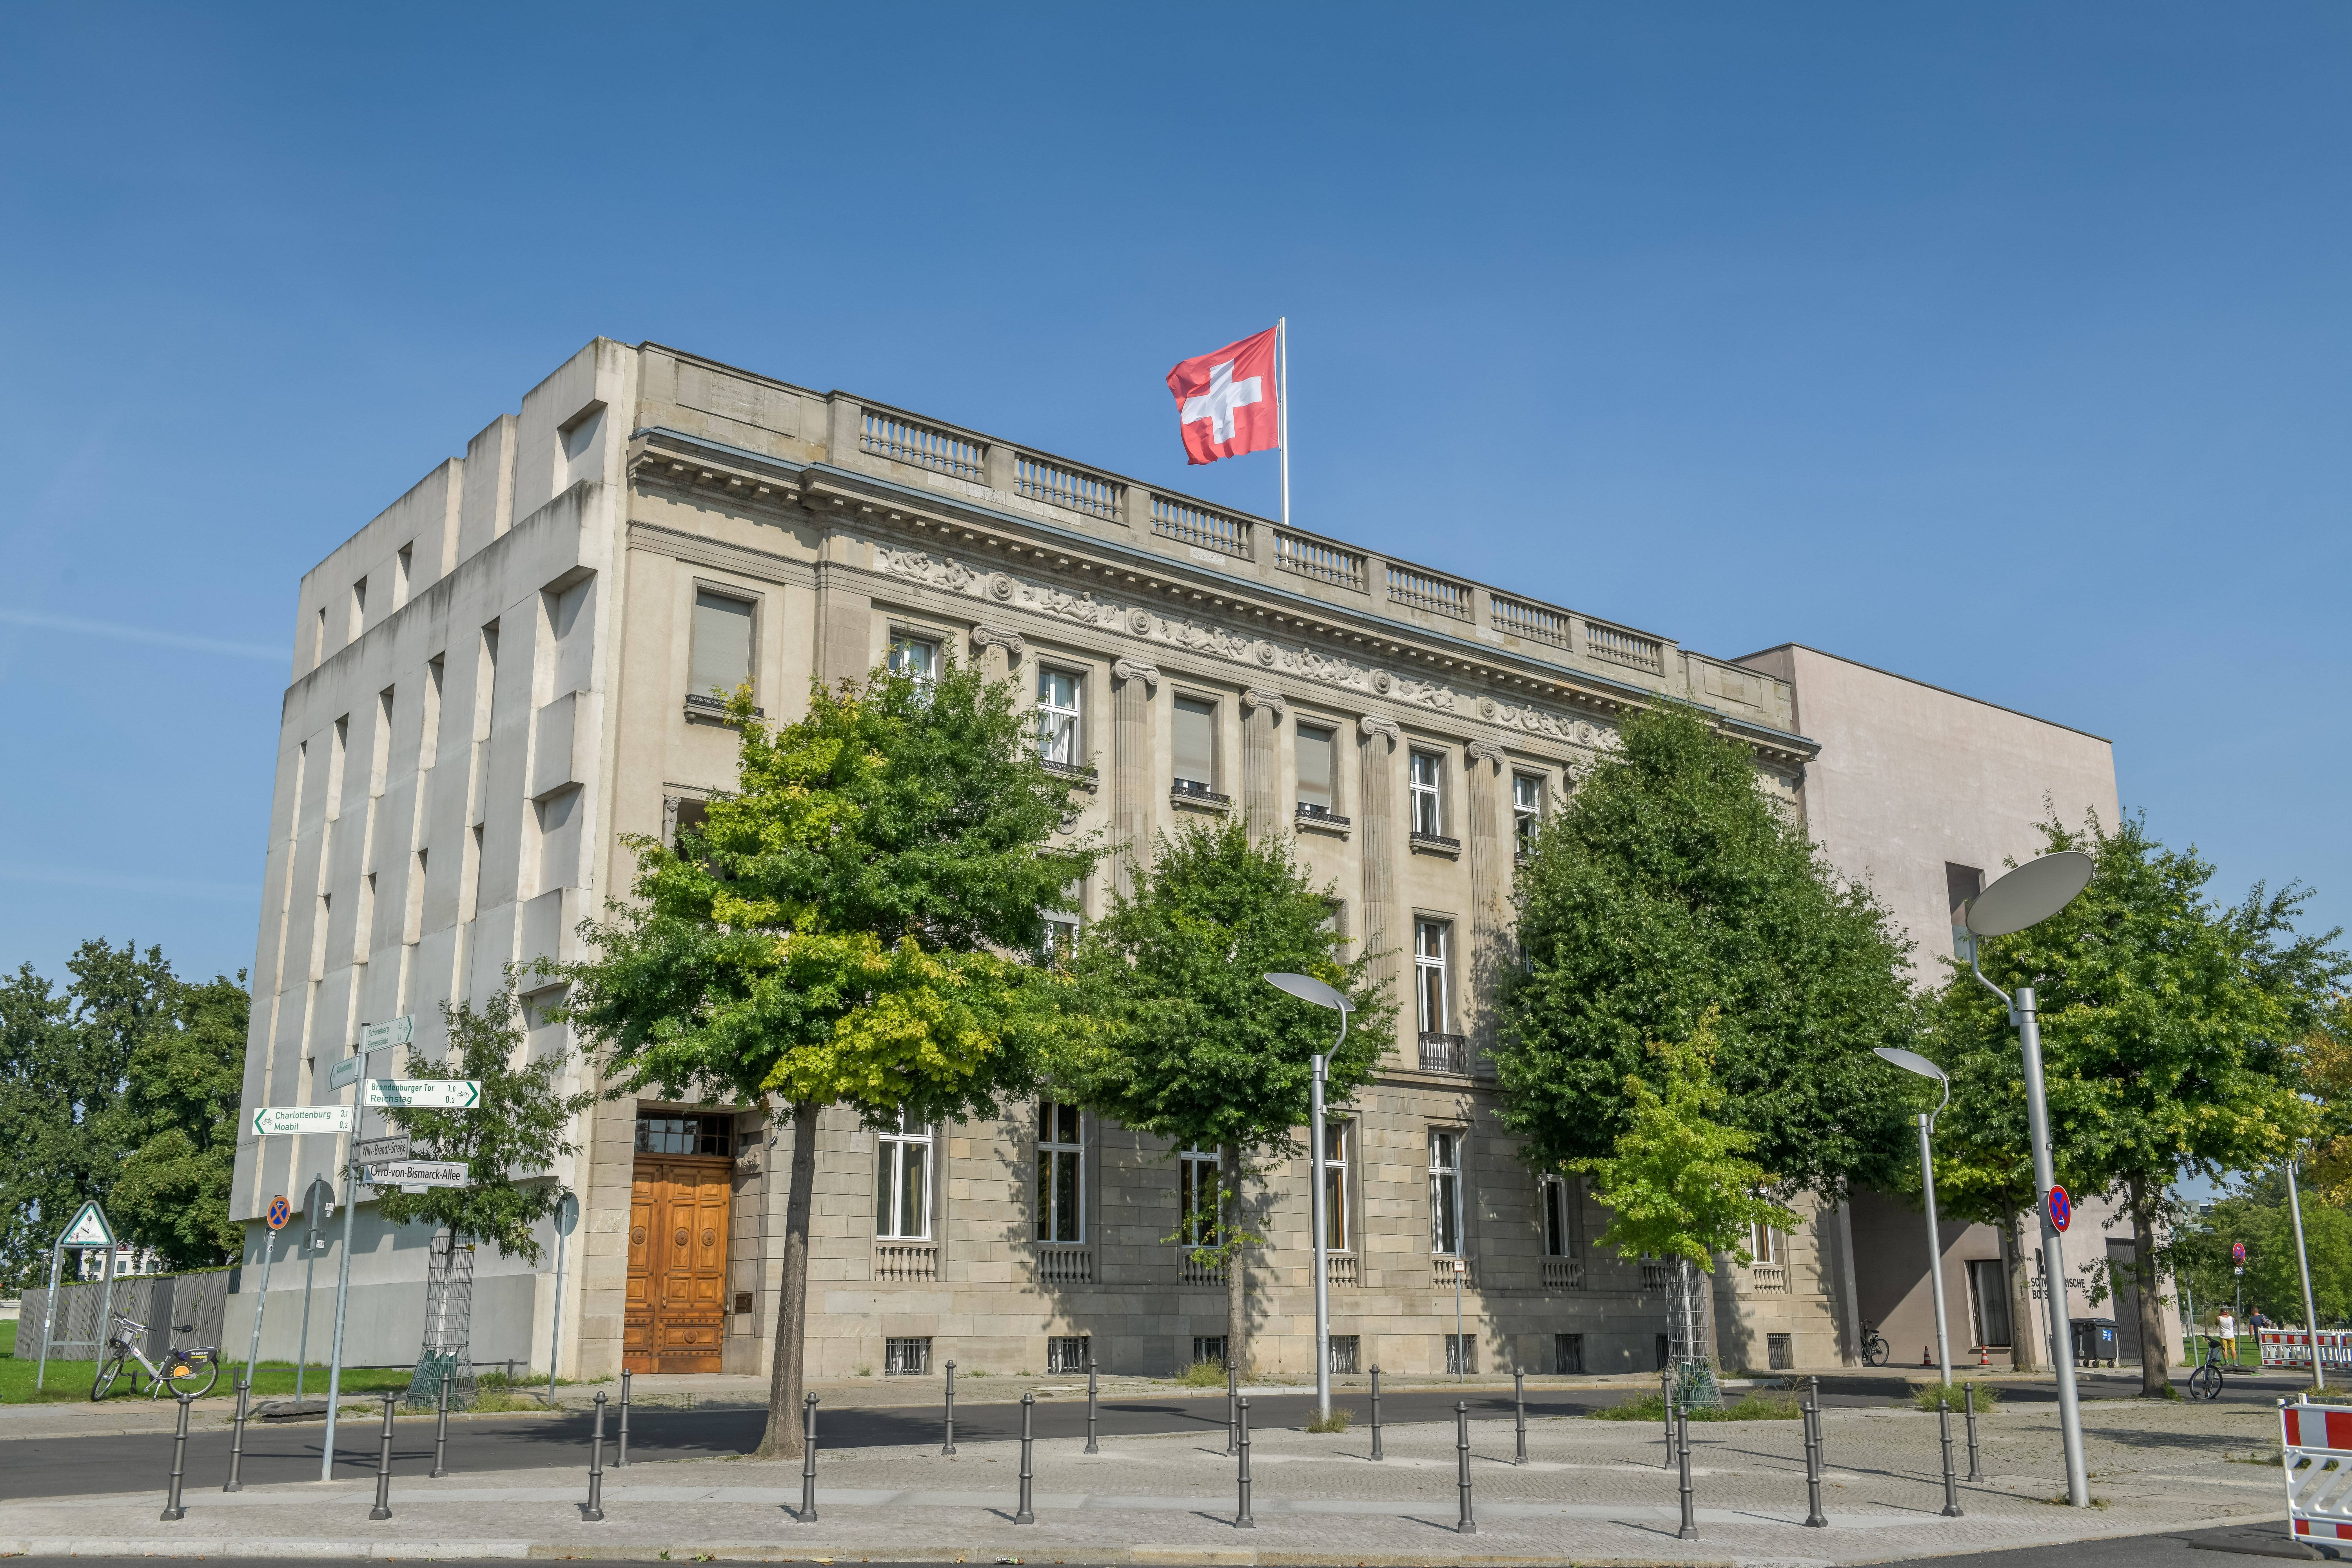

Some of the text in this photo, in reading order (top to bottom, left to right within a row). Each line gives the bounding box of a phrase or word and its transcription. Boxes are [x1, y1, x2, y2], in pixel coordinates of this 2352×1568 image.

[368, 1027, 389, 1037] Schöneberg
[367, 1036, 388, 1049] Siegessäule
[372, 1083, 422, 1093] Brandenburger
[370, 1094, 412, 1104] Reichstag
[276, 1111, 331, 1120] Charlottenburg
[362, 1141, 406, 1158] Willy-Brandt-Straße
[2031, 1277, 2085, 1288] SCRISCHE
